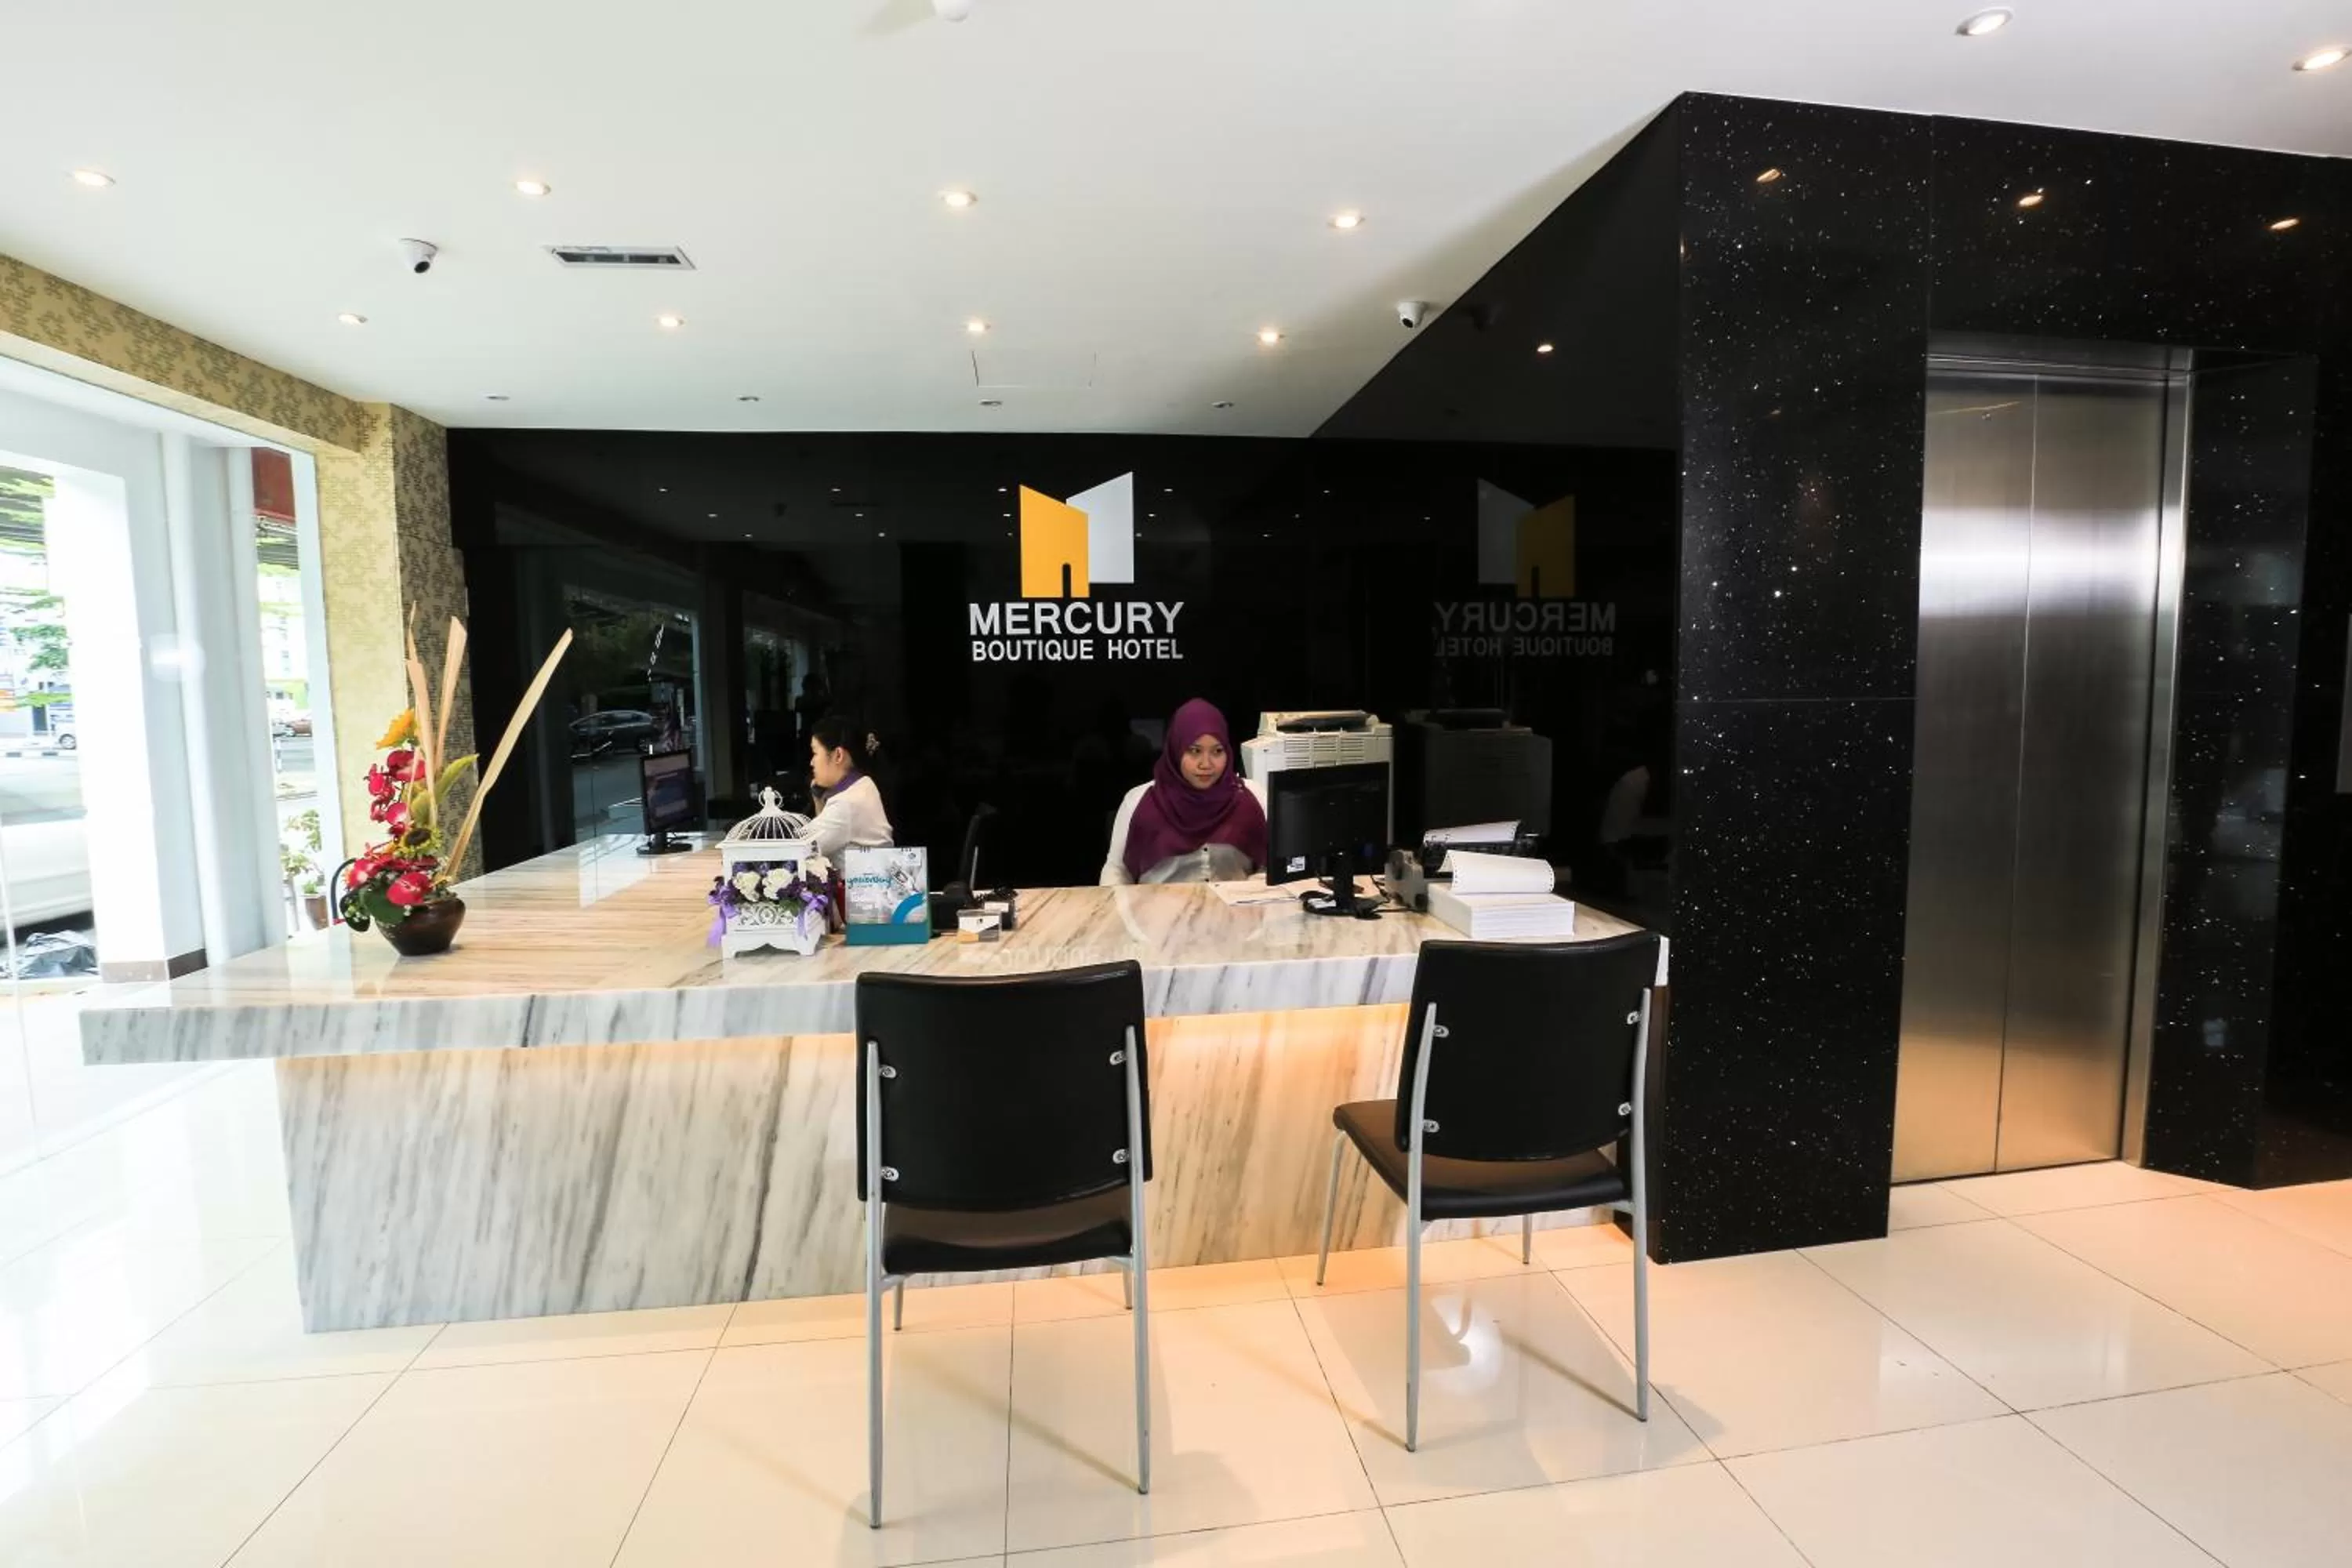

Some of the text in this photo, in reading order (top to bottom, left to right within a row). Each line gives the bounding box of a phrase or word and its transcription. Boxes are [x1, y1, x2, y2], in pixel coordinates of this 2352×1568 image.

[969, 601, 1185, 636] MERCURY
[971, 638, 1184, 662] BOUTIQUE HOTEL
